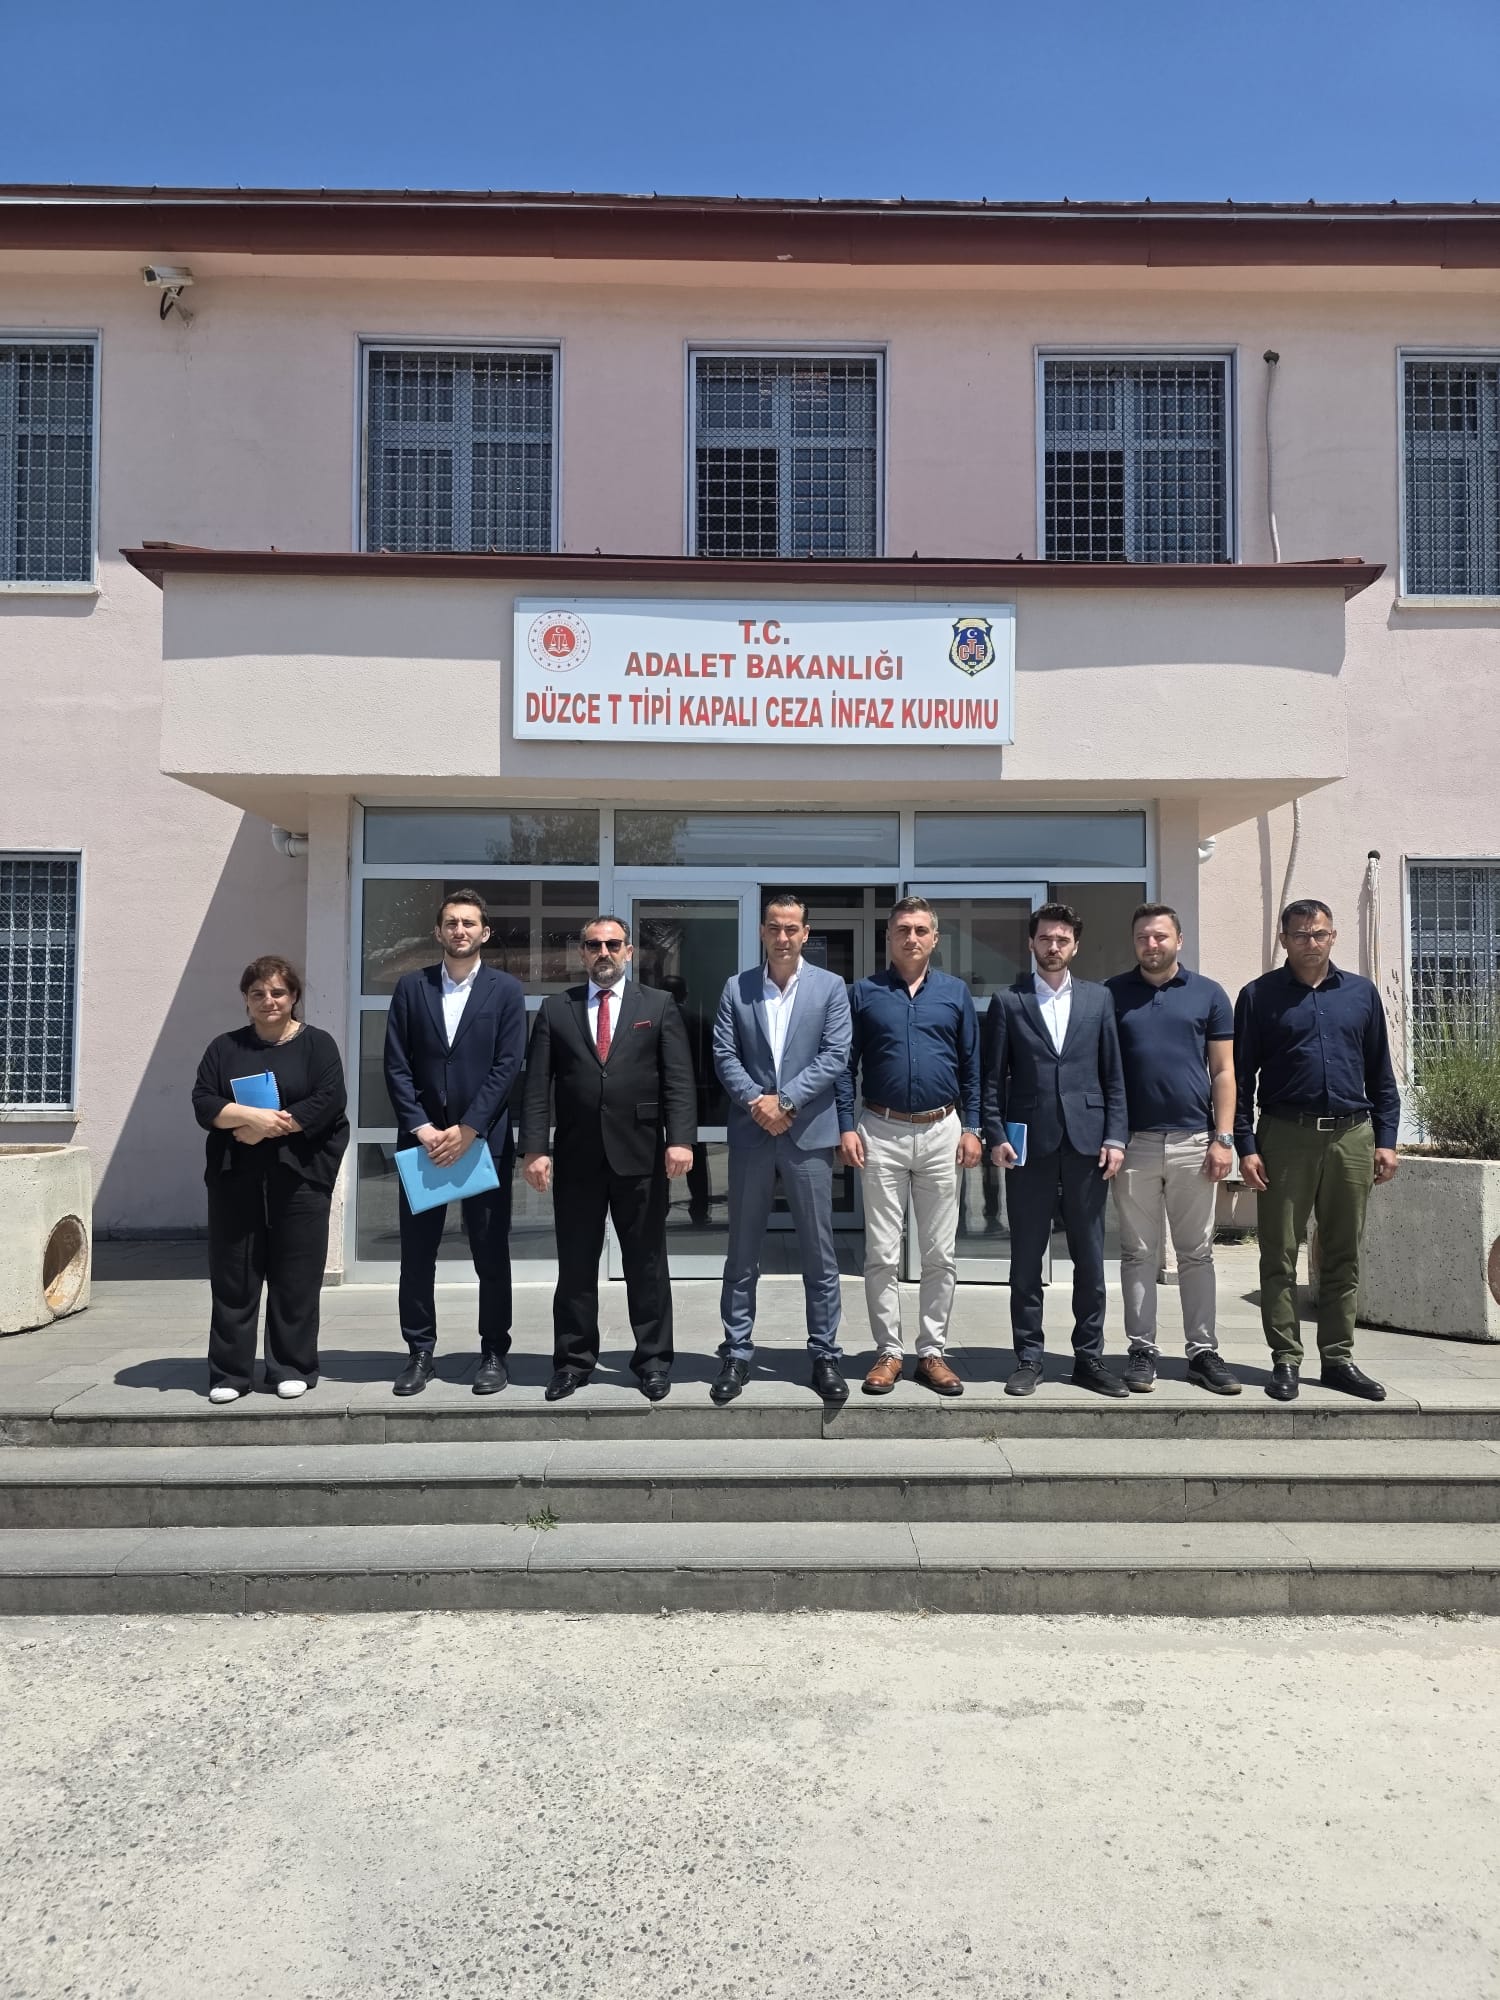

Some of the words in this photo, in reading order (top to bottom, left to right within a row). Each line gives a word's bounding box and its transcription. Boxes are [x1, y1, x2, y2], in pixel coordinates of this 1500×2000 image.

[738, 619, 789, 645] T.C.
[625, 651, 737, 679] ADALET
[747, 649, 902, 681] BAKANLIĞI
[526, 686, 601, 725] DÜZCE
[608, 693, 622, 725] T
[629, 687, 671, 726] TİPİ
[680, 695, 758, 727] KAPALI
[765, 697, 823, 728] CEZA
[831, 690, 894, 729] İNFAZ
[902, 698, 999, 730] KURUMU
